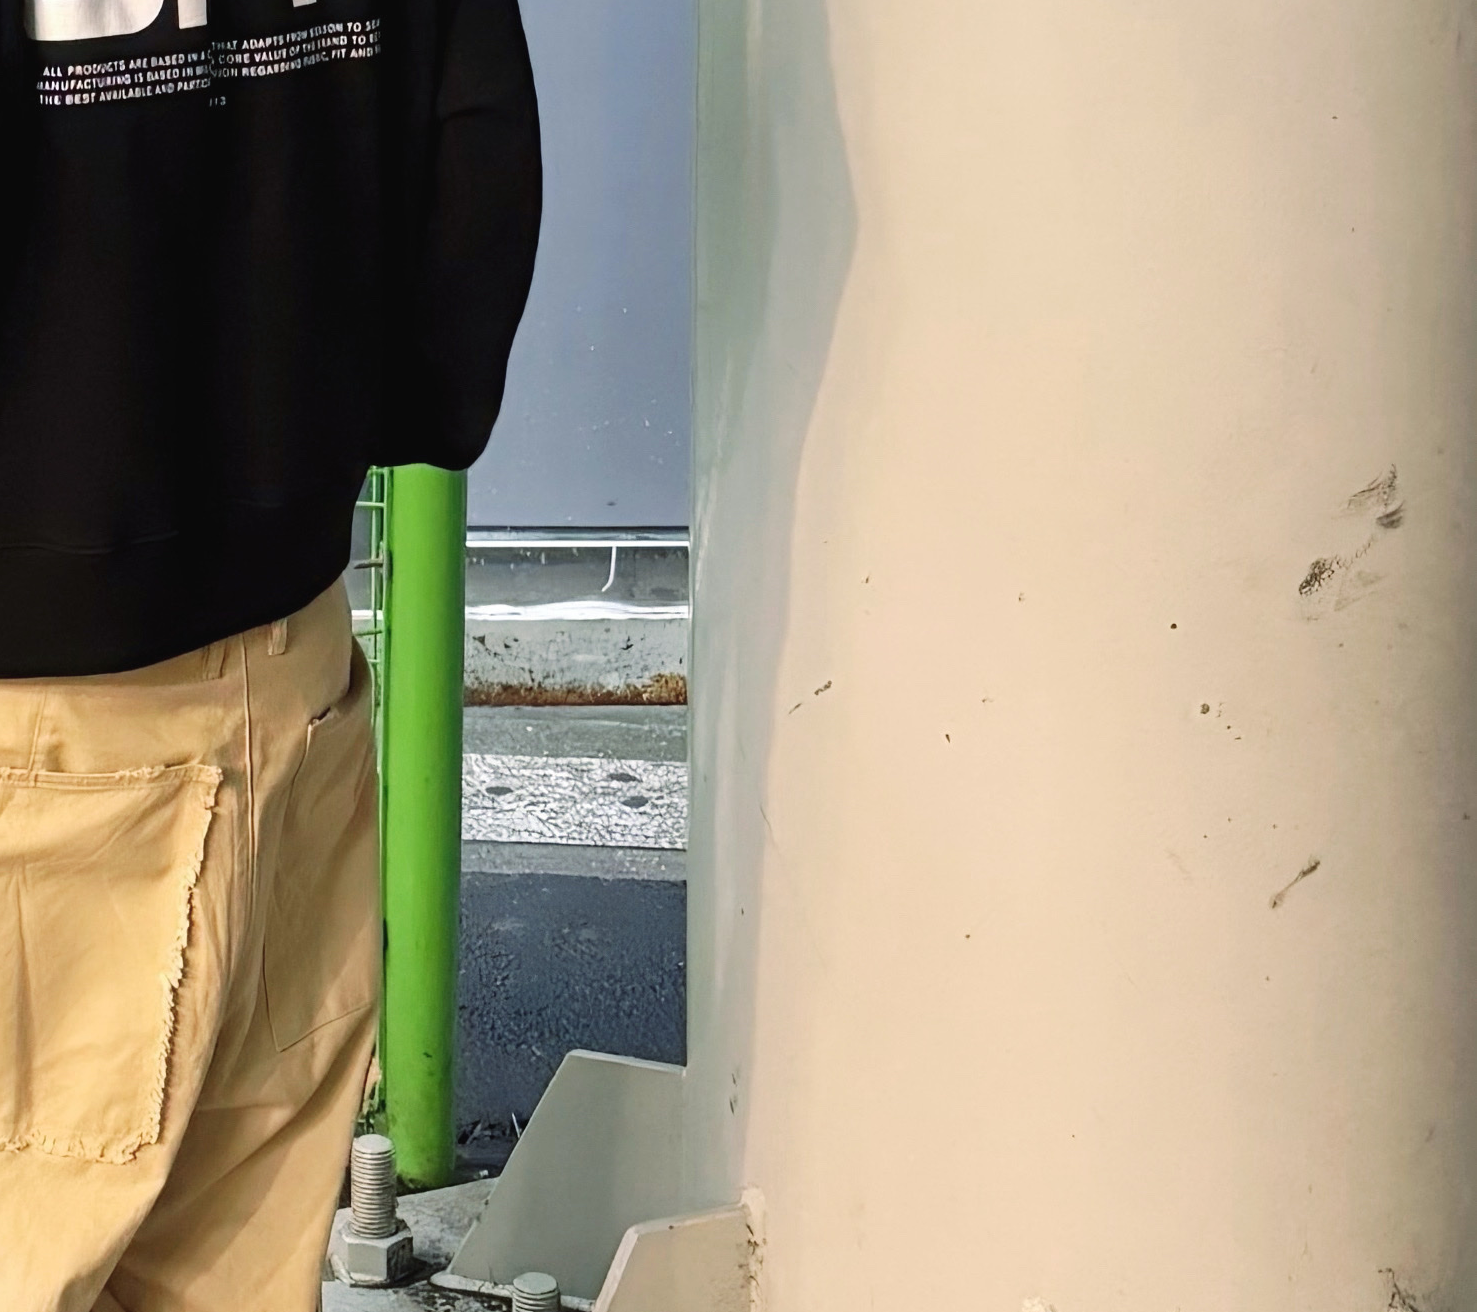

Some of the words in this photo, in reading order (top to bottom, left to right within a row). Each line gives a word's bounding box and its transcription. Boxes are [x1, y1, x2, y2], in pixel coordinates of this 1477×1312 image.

[43, 66, 63, 77] ALL
[129, 58, 148, 69] ARE
[151, 53, 185, 67] BASED
[242, 34, 284, 49] ADAPTS
[347, 22, 362, 32] TO
[147, 68, 179, 81] BASED
[352, 35, 366, 45] TO
[65, 92, 96, 106] BEST
